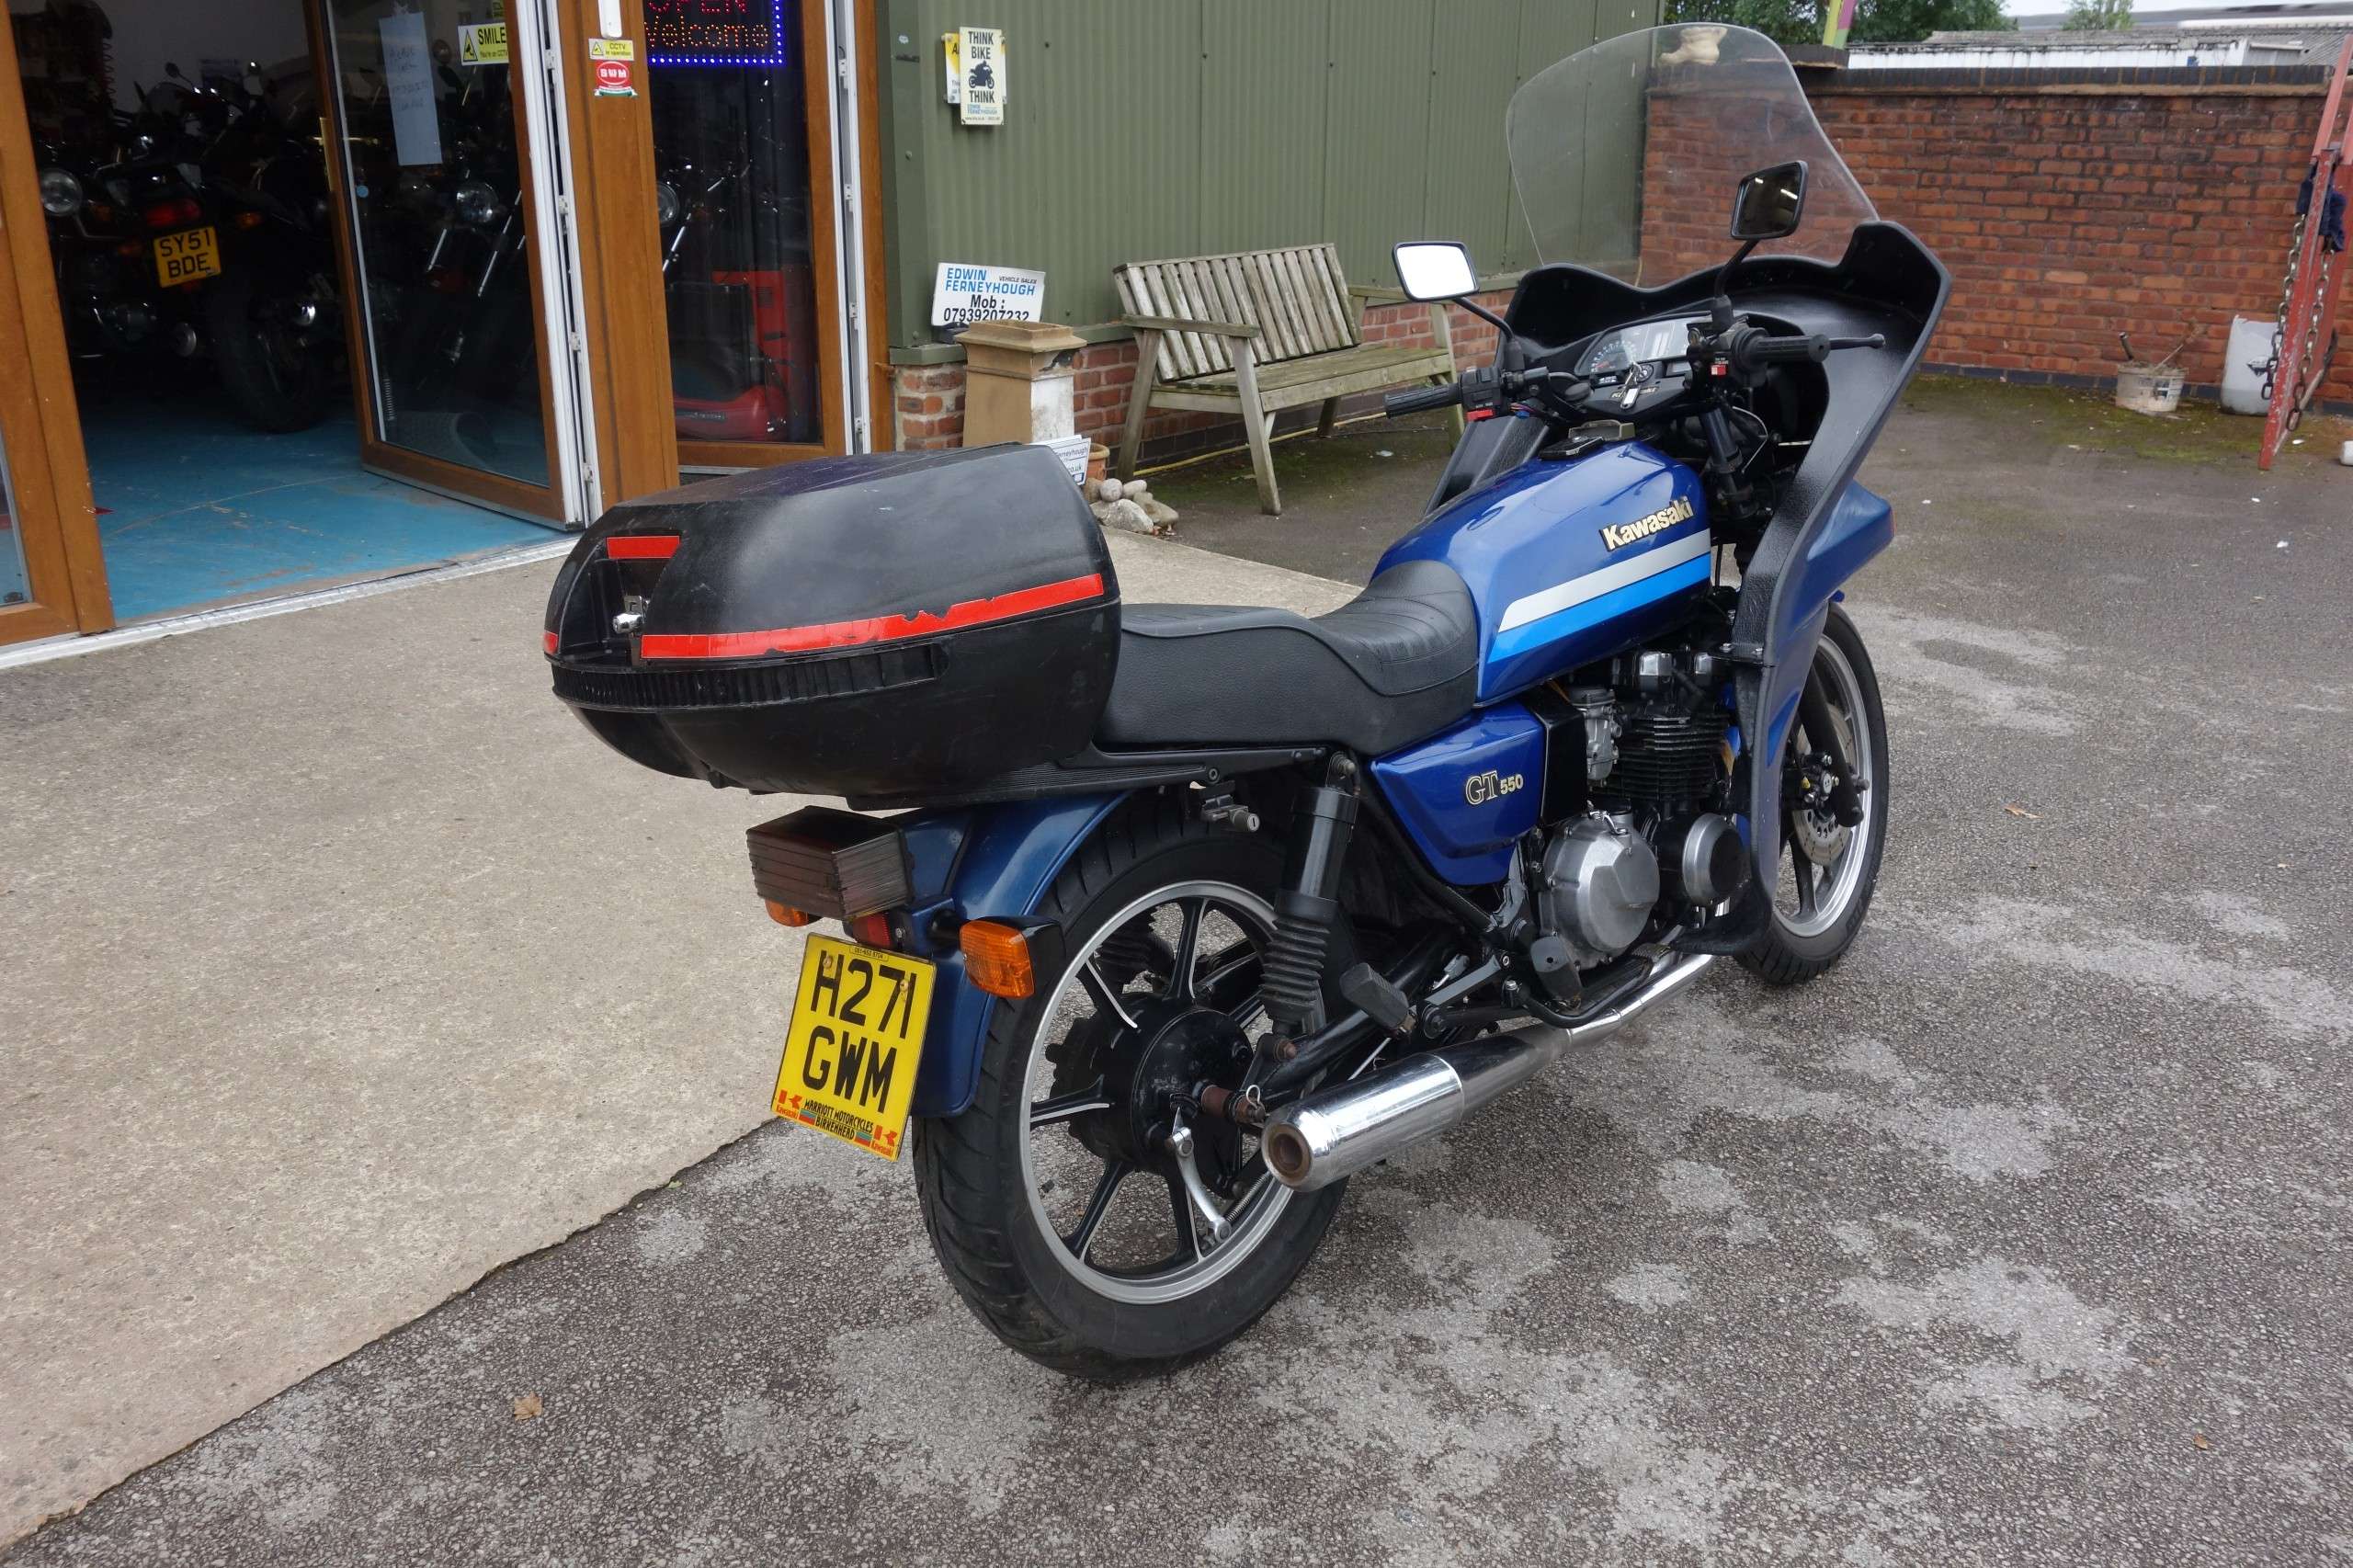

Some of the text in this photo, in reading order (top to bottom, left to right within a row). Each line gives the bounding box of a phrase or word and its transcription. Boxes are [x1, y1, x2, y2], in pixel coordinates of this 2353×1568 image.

[478, 27, 506, 45] SMILE
[968, 31, 994, 44] THINK
[972, 46, 991, 59] BIKE
[969, 90, 995, 103] THINK
[160, 229, 210, 257] SY51
[167, 253, 210, 278] BDE
[947, 267, 987, 280] EDWIN
[946, 279, 1035, 296] FERNEYHOUGH
[971, 294, 996, 309] Mob
[944, 308, 1029, 323] 07939207232
[1601, 495, 1694, 551] Kawasaki
[1466, 770, 1524, 805] GT 550
[811, 949, 917, 1040] H271
[802, 1025, 897, 1114] GWM
[804, 1098, 873, 1133] MARRIOTT MOTORCYCLES
[815, 1116, 855, 1140] BIRKENHEAD
